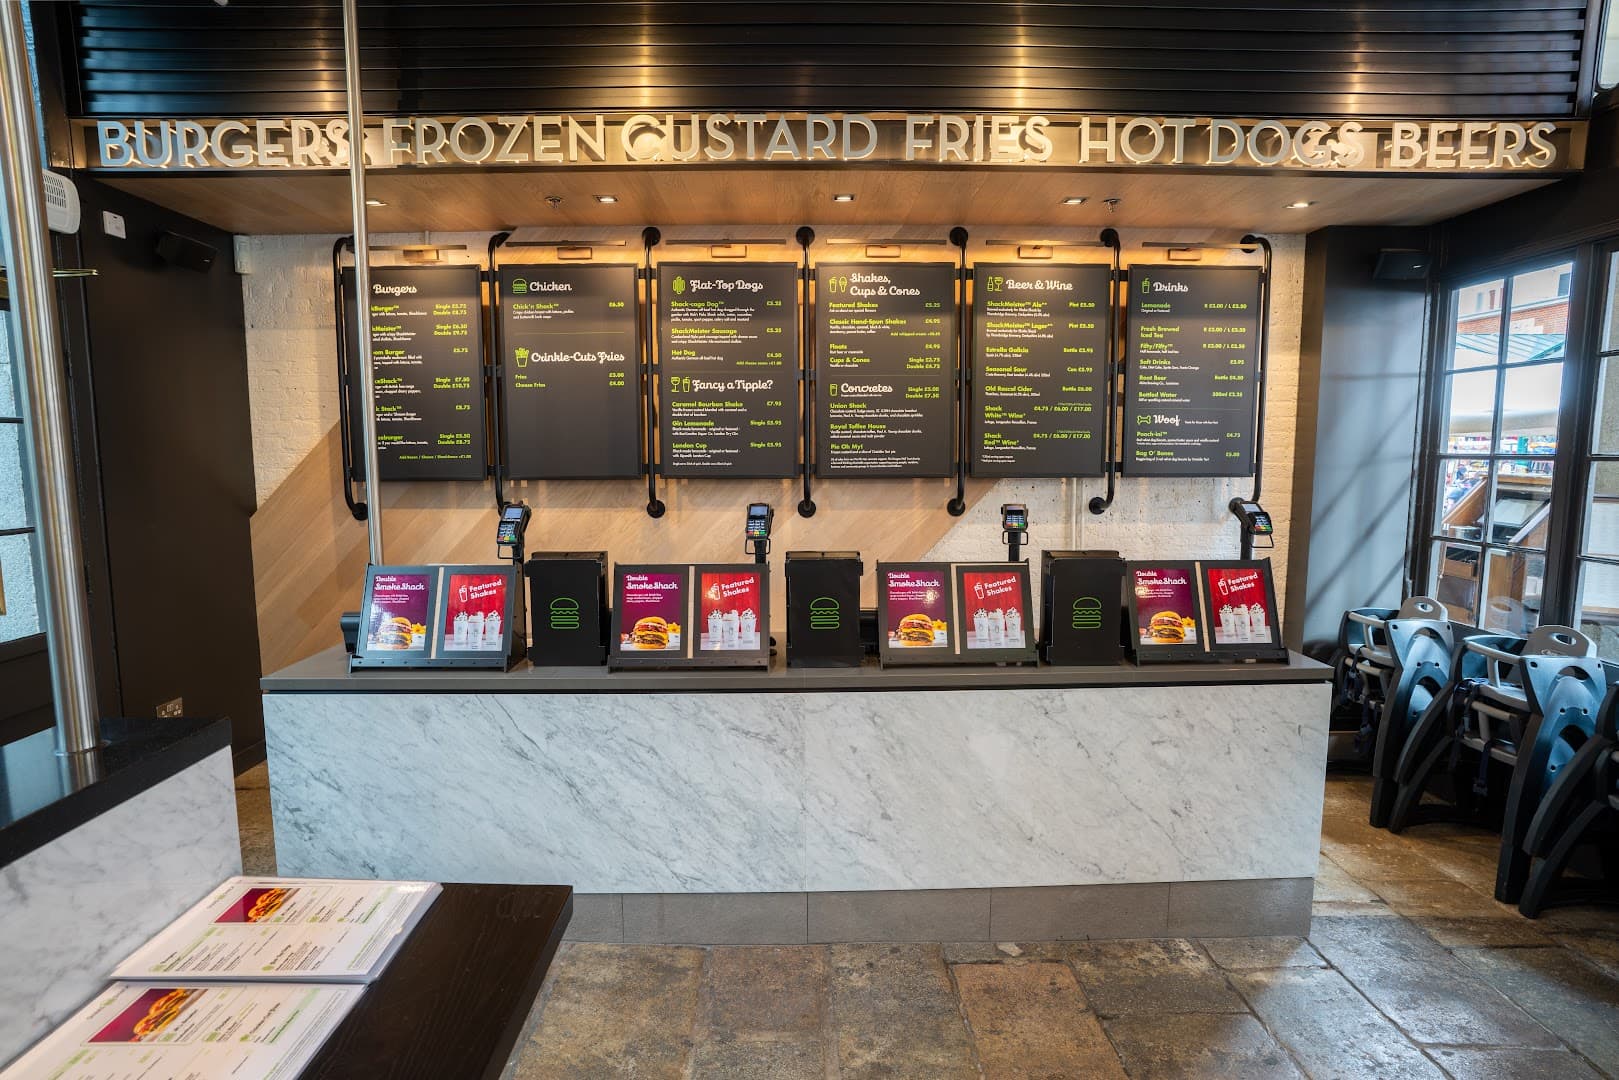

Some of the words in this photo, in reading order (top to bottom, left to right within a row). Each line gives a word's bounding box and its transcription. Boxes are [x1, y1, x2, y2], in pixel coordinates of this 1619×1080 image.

[97, 118, 350, 168] BURGERS
[383, 114, 607, 165] FROZEN
[621, 114, 878, 161] CUSTARD
[906, 114, 1053, 162] FRIES
[1078, 117, 1195, 164] HOT
[1206, 118, 1364, 166] DOGS
[1390, 121, 1556, 168] BEERS
[850, 273, 891, 284] Shakes,
[372, 284, 417, 296] Burgers
[529, 281, 572, 291] Chicken
[690, 280, 734, 292] Flat-Top
[736, 280, 764, 292] Dogs
[1006, 280, 1033, 290] Beer
[1034, 280, 1044, 290] &
[1045, 280, 1073, 290] Wine
[1153, 282, 1189, 292] Drinks
[850, 286, 876, 298] Cups
[877, 286, 888, 296] &
[889, 286, 921, 296] Cones
[384, 349, 405, 357] Burger
[531, 352, 597, 362] Crinkle-Cuts
[597, 352, 625, 364] Fries
[692, 380, 725, 392] Fancy
[735, 380, 773, 392] Tipple?
[841, 383, 893, 393] Concretes
[1153, 415, 1180, 426] Woof
[721, 577, 754, 590] Featured
[888, 579, 940, 587] SmokeShack
[984, 575, 1016, 590] Featured
[1137, 577, 1187, 585] SmokeShack
[1228, 573, 1258, 585] Featured
[374, 582, 425, 591] SmokeShack
[469, 579, 503, 592] Featured
[626, 581, 678, 590] SmokeShack
[1230, 582, 1255, 592] Shakes
[470, 589, 497, 600] Shakes
[722, 587, 750, 598] Shakes
[986, 586, 1012, 597] Shakes
